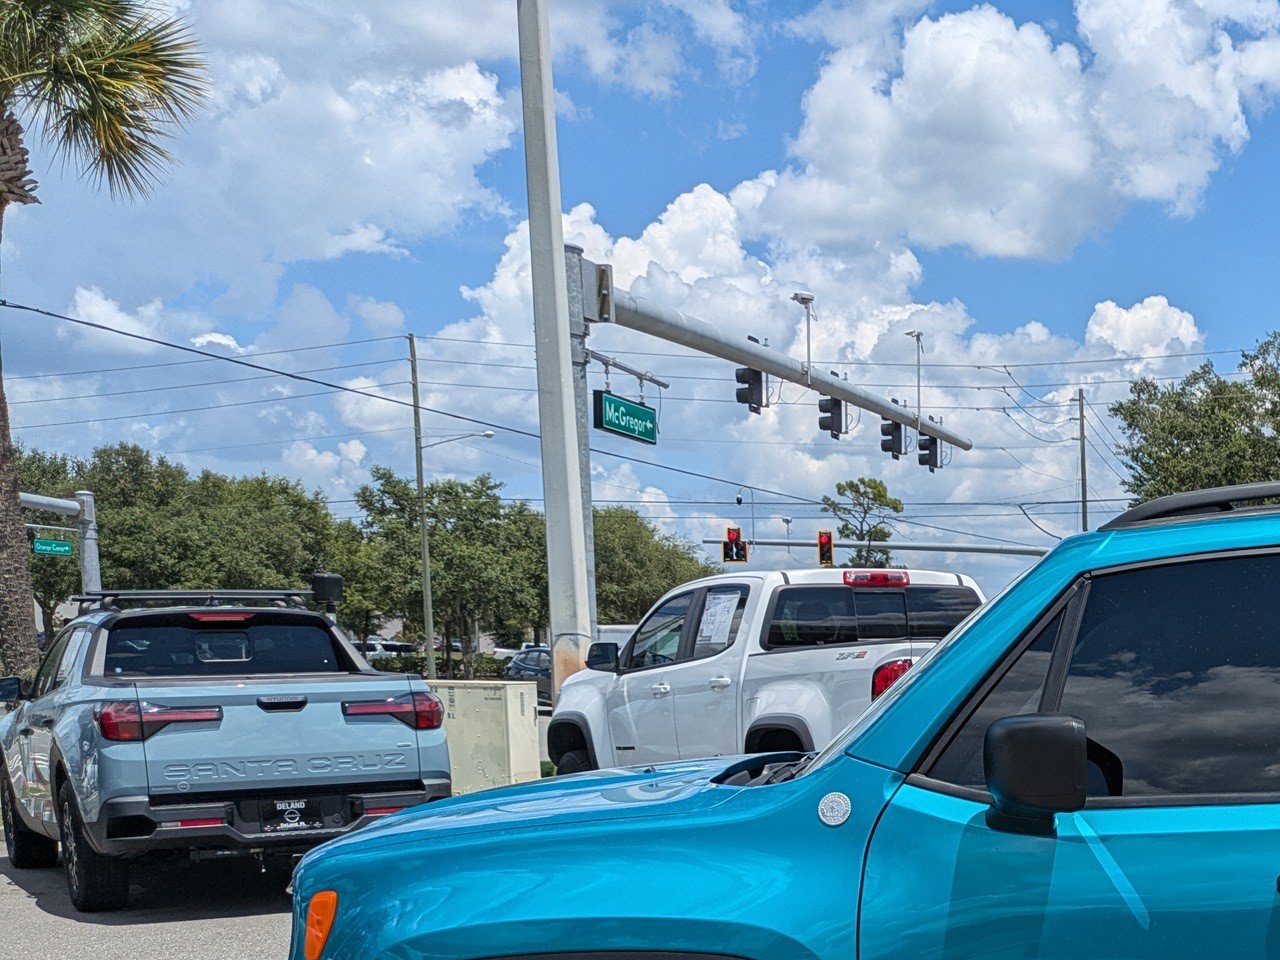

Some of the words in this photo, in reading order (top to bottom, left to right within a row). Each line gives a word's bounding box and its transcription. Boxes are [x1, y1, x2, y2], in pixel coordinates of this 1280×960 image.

[606, 402, 646, 434] McGregor
[164, 757, 298, 781] SANTA
[307, 753, 406, 774] CRUZ
[276, 801, 306, 810] DELAND
